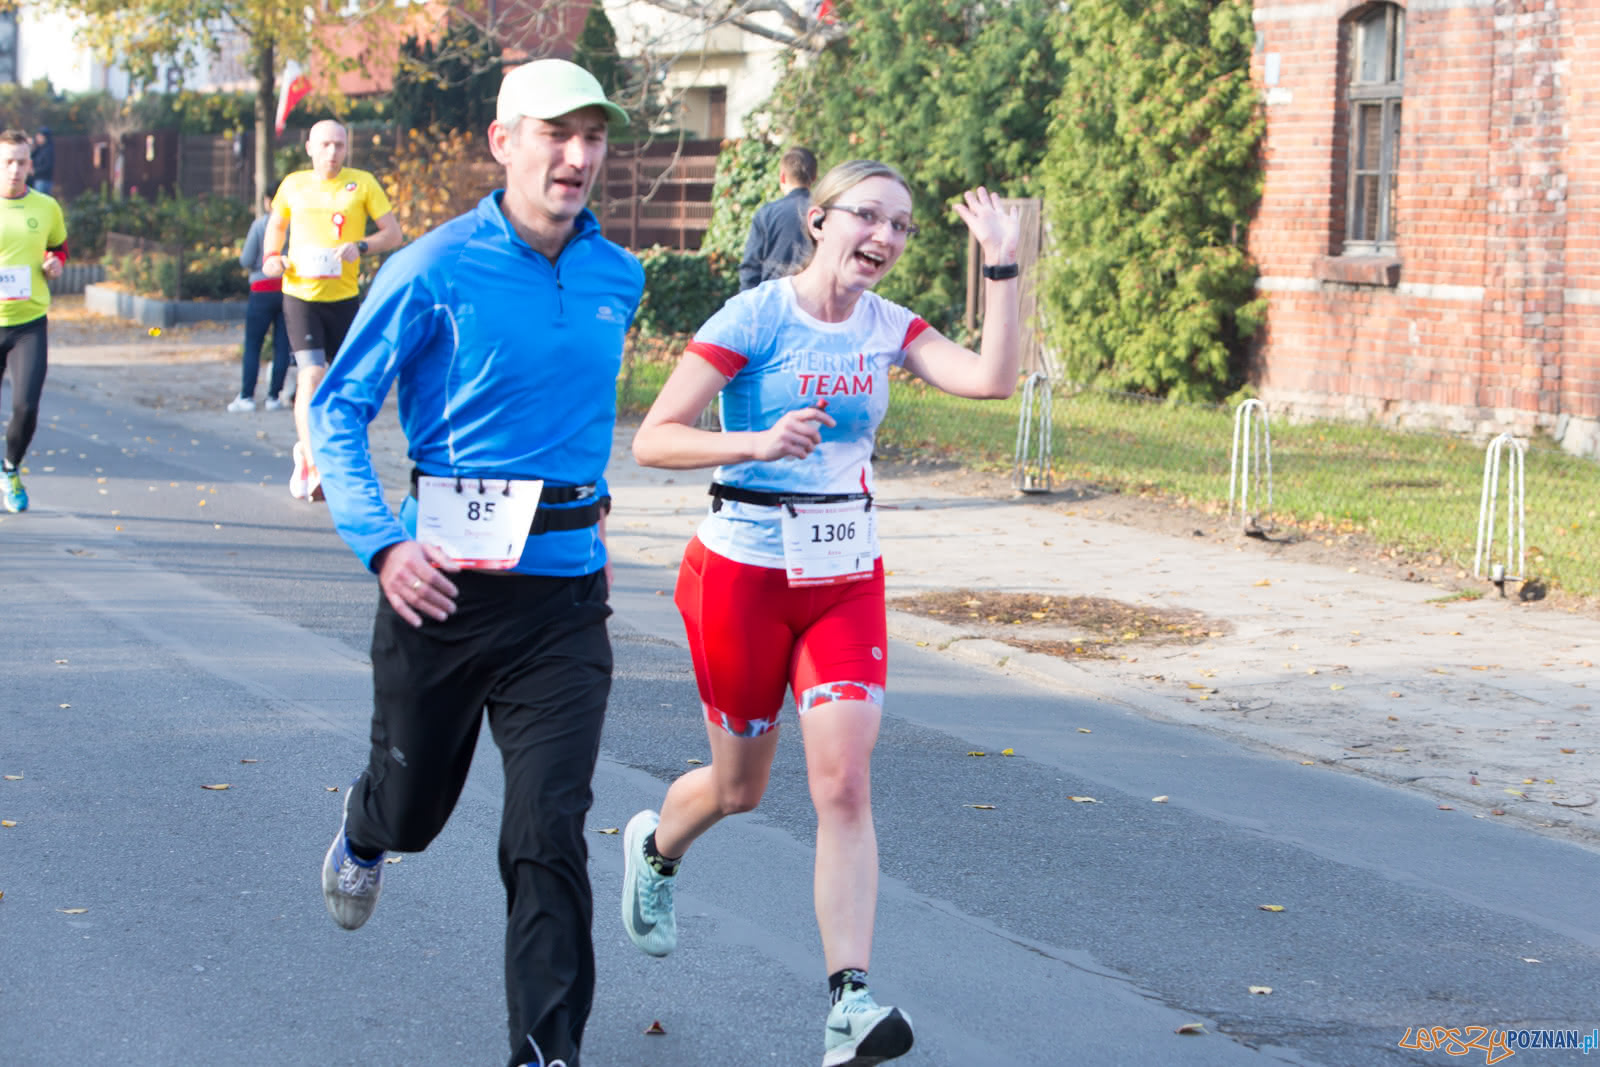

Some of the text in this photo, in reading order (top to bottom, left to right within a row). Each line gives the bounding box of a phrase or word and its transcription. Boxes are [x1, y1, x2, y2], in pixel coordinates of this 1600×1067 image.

[798, 374, 872, 396] TEAM
[467, 501, 496, 521] 85
[811, 522, 856, 543] 1306
